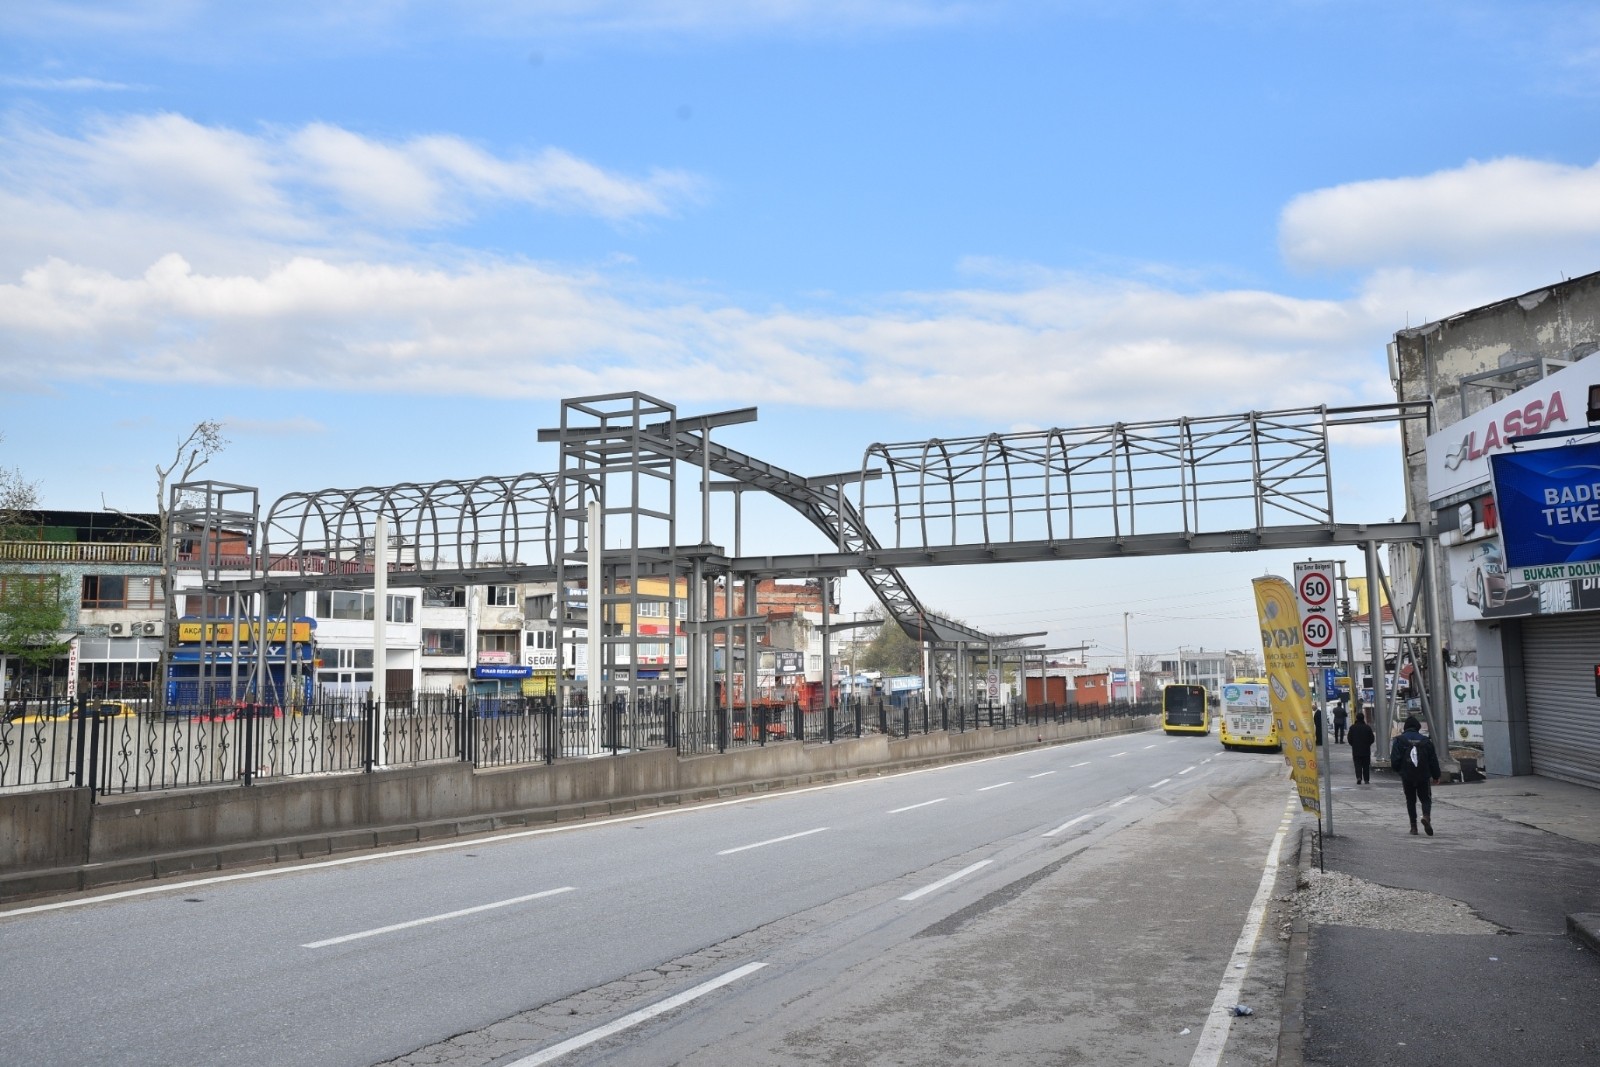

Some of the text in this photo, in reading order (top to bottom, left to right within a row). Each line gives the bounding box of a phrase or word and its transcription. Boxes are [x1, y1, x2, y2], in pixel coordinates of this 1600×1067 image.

[1468, 391, 1568, 461] LASSA
[1543, 483, 1600, 506] BADE
[1542, 504, 1600, 526] TEKE
[1523, 566, 1565, 580] BUKART
[1305, 581, 1325, 597] 50
[1307, 624, 1327, 639] 50
[1467, 706, 1481, 716] 25
